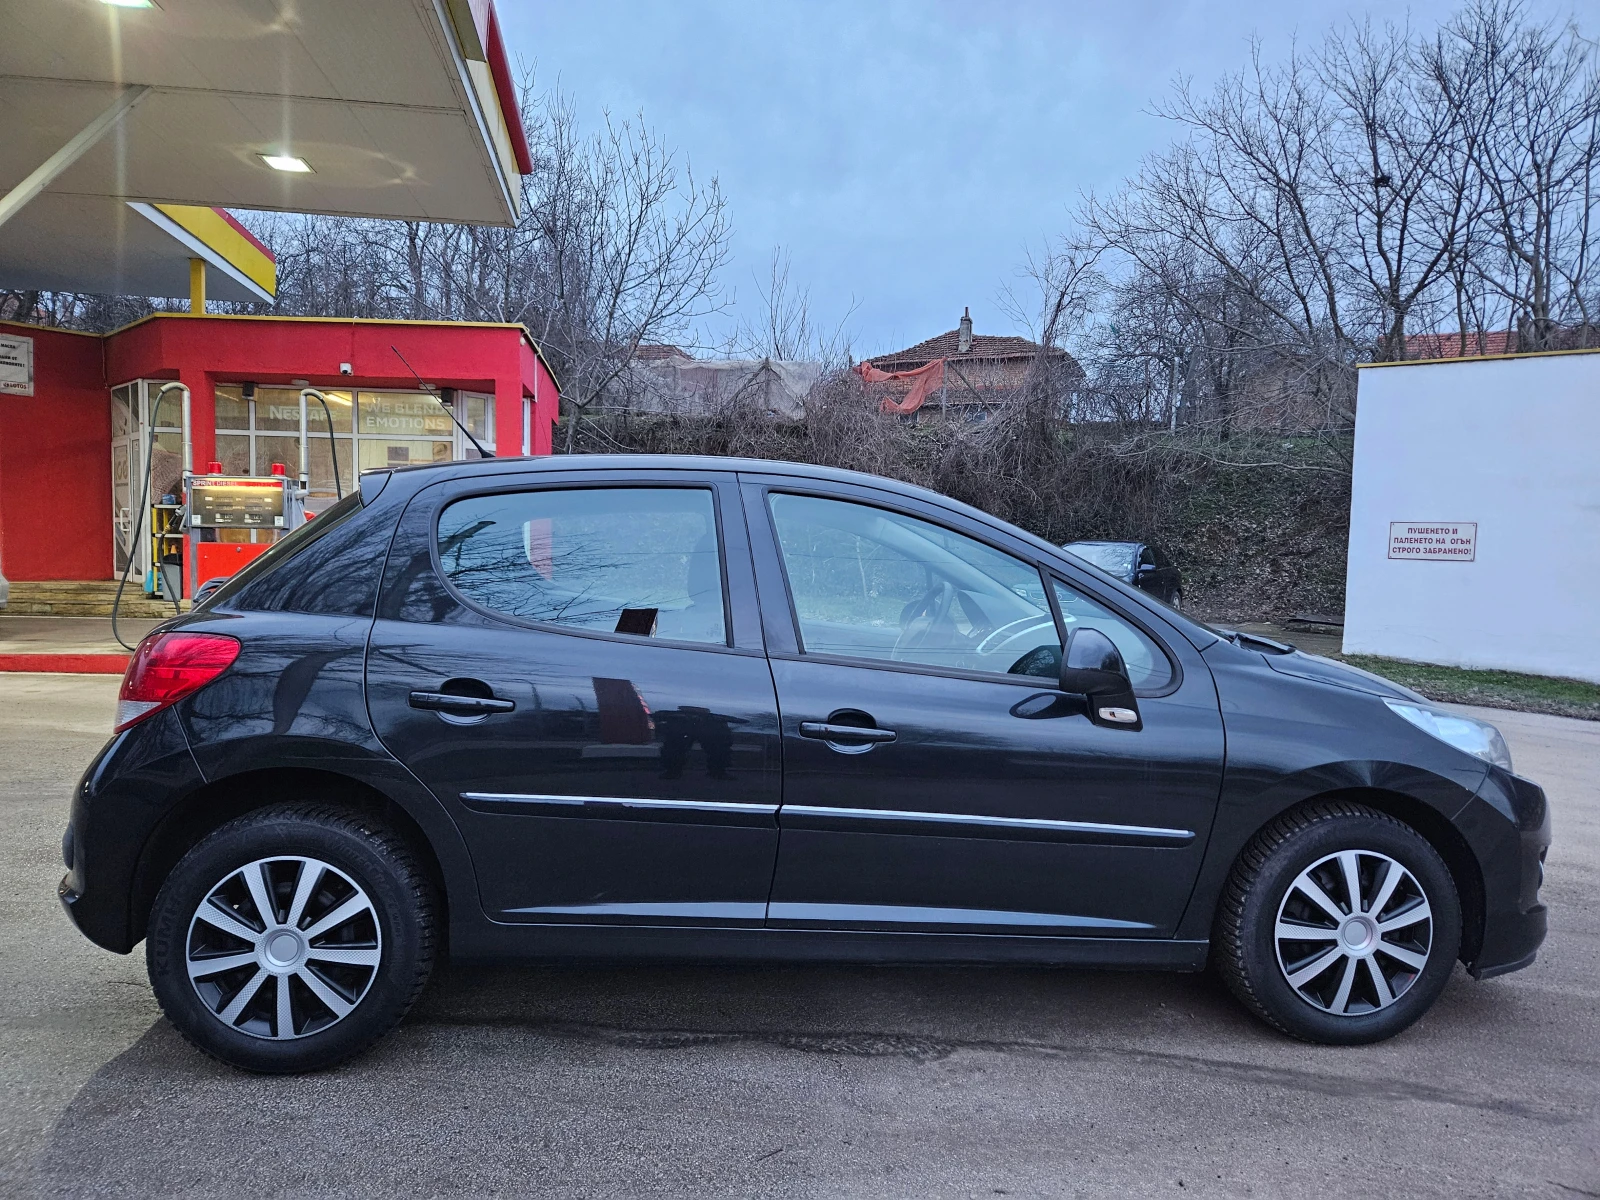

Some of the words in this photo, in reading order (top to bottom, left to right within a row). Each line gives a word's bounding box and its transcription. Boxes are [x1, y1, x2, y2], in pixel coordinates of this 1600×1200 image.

[366, 403, 391, 413] WE
[394, 403, 445, 415] BLEND
[366, 416, 446, 429] EMOTIONS
[1407, 527, 1450, 535] ПУШЕНЕТО
[1392, 546, 1421, 554] СТРОГО
[1422, 547, 1472, 555] ЗАБРАНЕНО!
